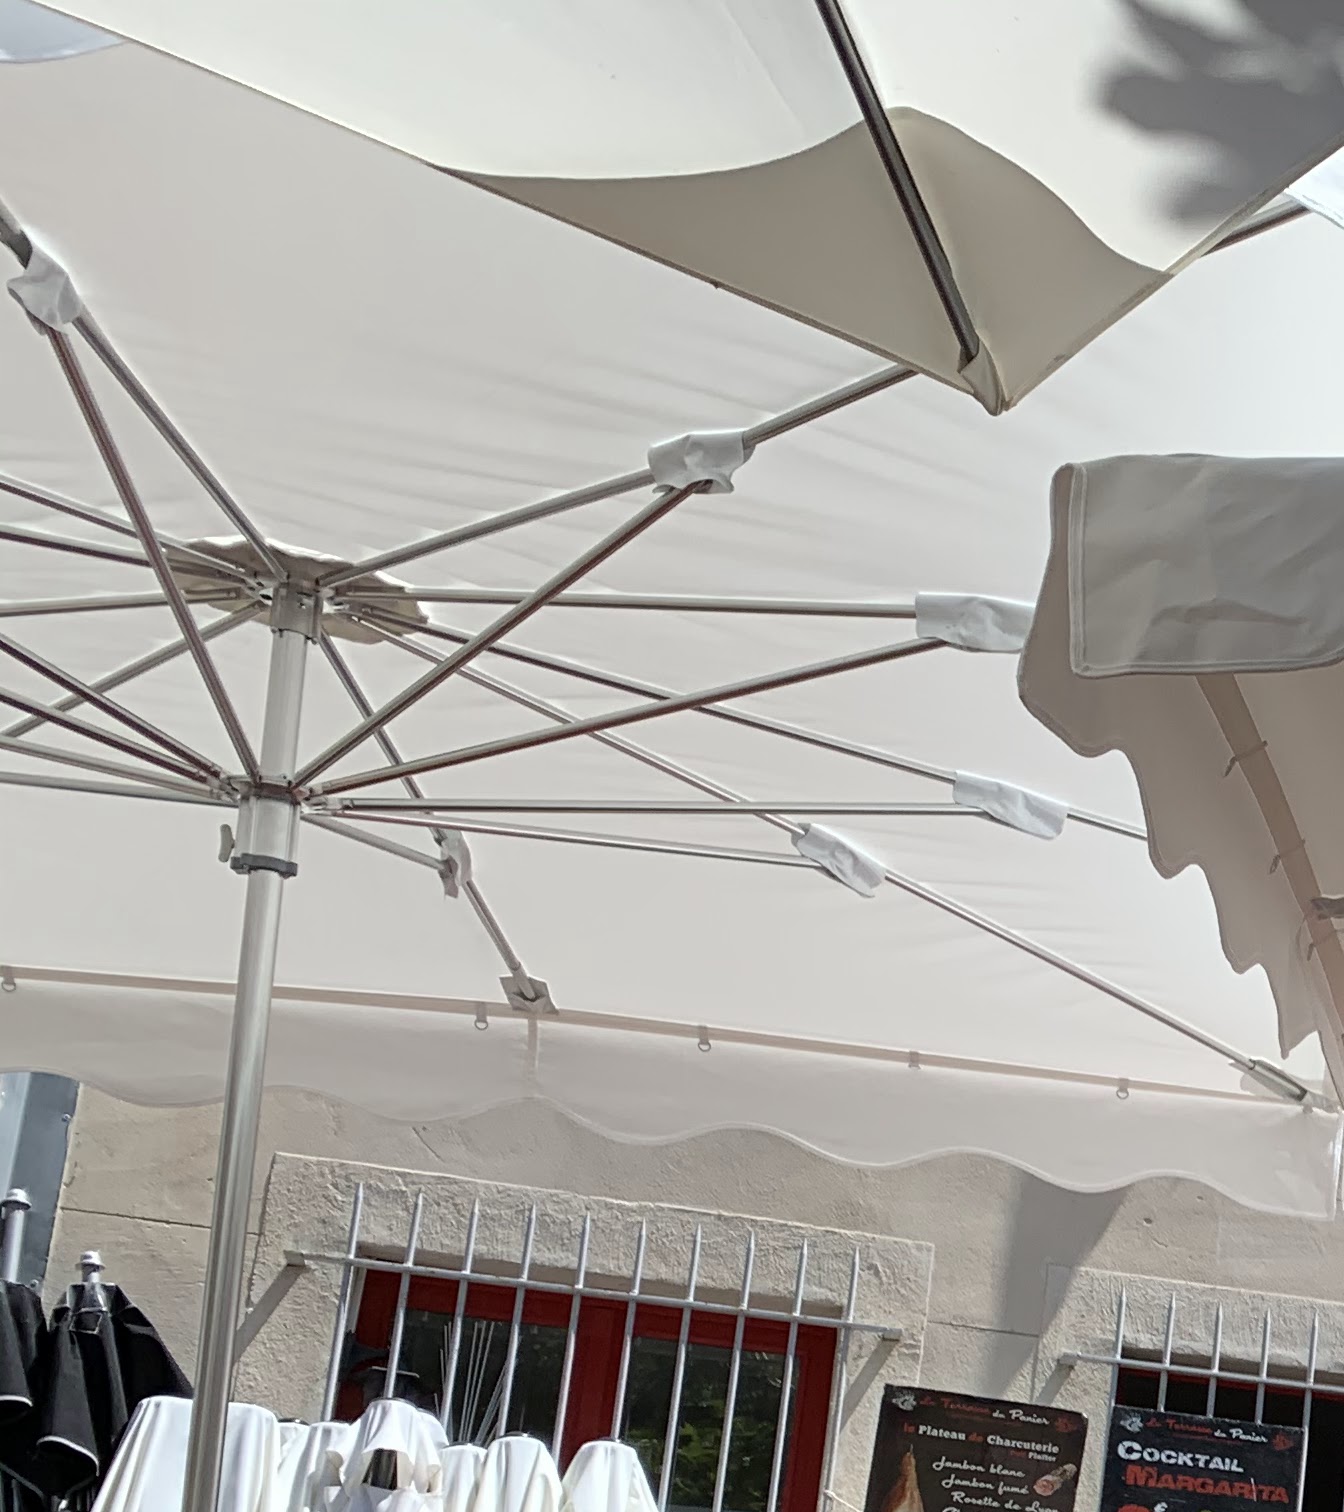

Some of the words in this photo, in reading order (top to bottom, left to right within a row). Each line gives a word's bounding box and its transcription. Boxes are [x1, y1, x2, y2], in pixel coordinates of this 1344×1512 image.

[1009, 1409, 1050, 1425] Panier
[918, 1425, 966, 1441] Plateau
[987, 1435, 1059, 1453] Charcuterie
[1229, 1428, 1268, 1443] Panier
[932, 1456, 985, 1472] Jambon
[990, 1464, 1025, 1477] blanc
[941, 1474, 995, 1490] Jambon
[1125, 1464, 1289, 1503] MARGARITA
[951, 1491, 1000, 1508] Rosette
[1004, 1500, 1021, 1510] de
